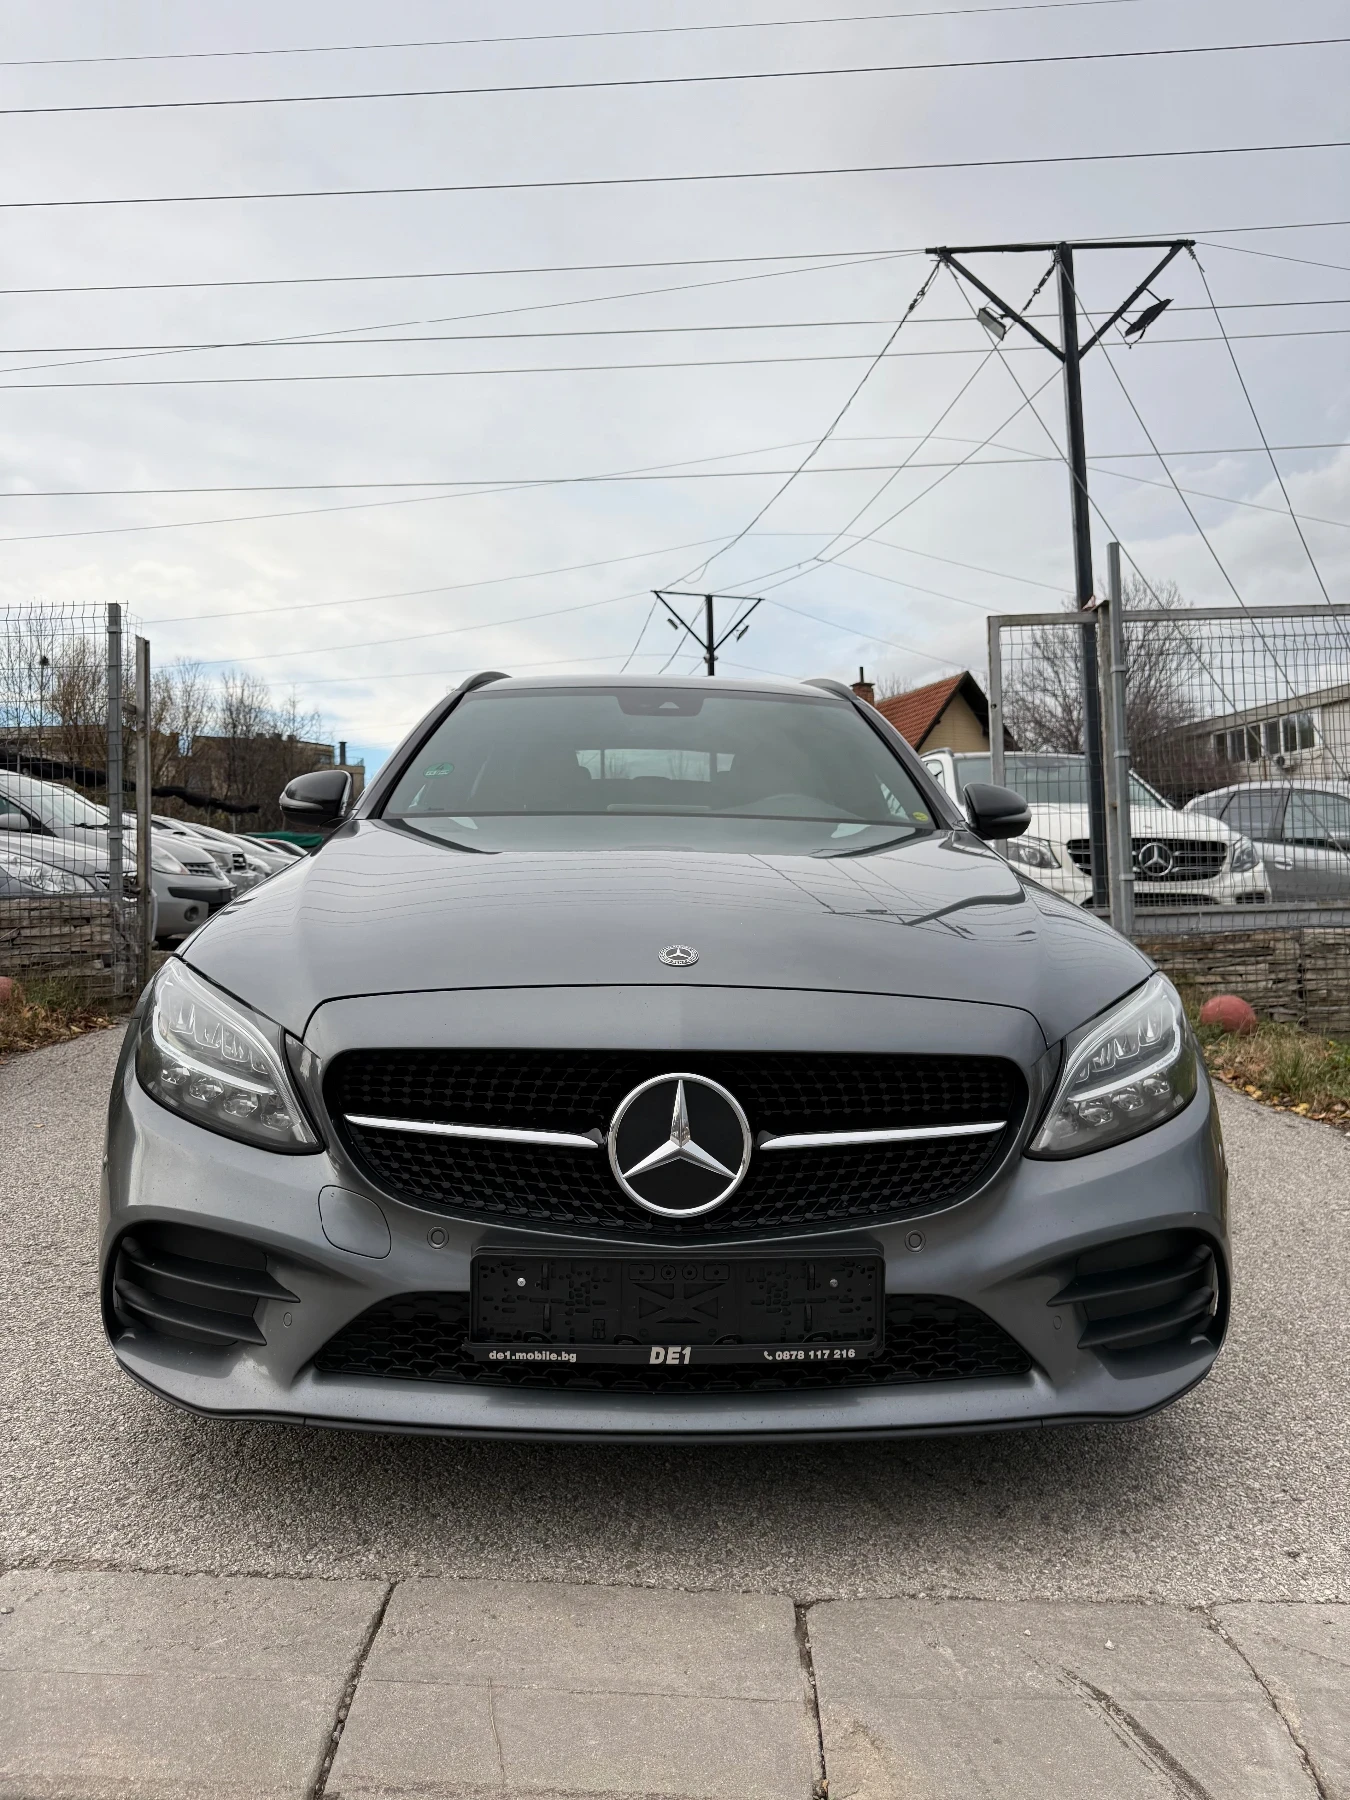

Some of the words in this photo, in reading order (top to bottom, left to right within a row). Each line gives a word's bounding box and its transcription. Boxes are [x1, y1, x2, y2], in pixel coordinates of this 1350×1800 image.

[488, 1350, 577, 1363] de1.mobile.bg
[649, 1346, 692, 1365] DE1
[775, 1350, 805, 1360] 0878
[808, 1350, 830, 1359] 117
[833, 1349, 856, 1359] 216
